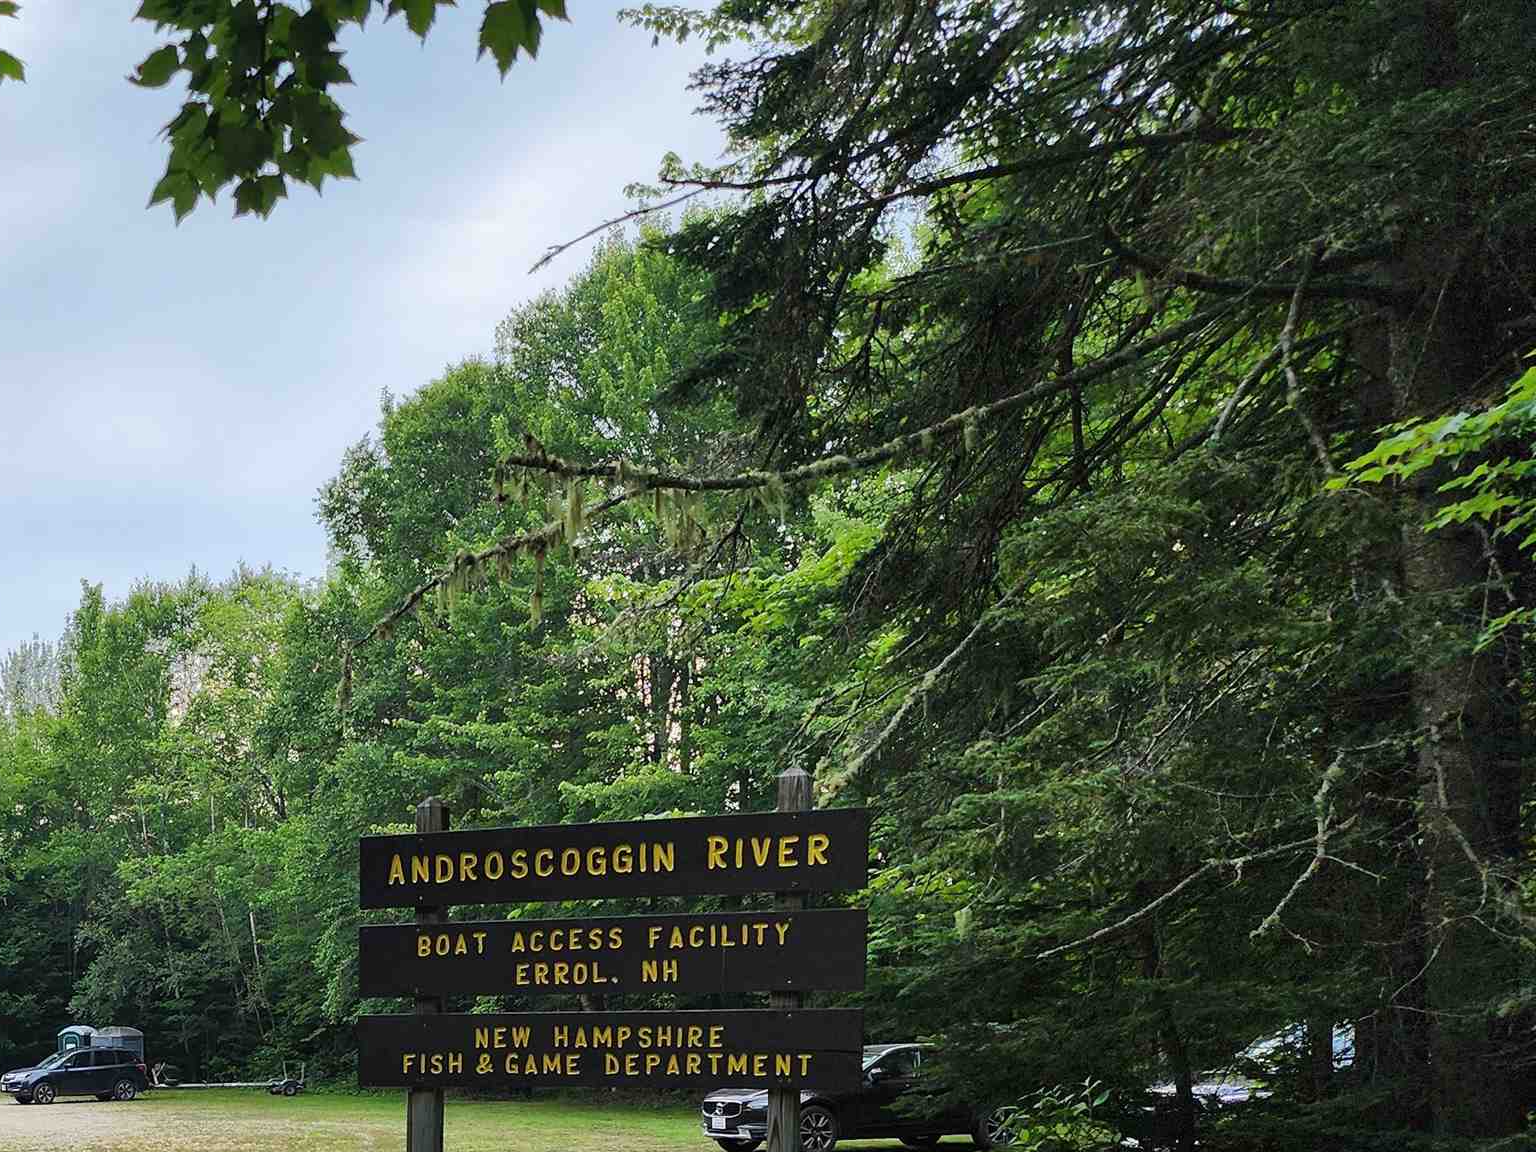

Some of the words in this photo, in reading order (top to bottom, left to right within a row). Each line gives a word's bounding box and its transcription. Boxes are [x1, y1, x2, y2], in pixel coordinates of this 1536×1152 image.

[389, 841, 674, 885] ANDROSCOGGIN
[708, 834, 829, 869] RIVER
[417, 930, 486, 956] BOAT
[512, 928, 622, 952] ACCESS
[649, 921, 790, 948] FACILITY
[642, 960, 677, 982] NH
[476, 1027, 530, 1048] NEW
[555, 1026, 724, 1048] HAMPSHIRE
[403, 1053, 462, 1074] FISH
[476, 1054, 493, 1074] &
[506, 1053, 580, 1075] GAME
[606, 1054, 812, 1076] DEPARTMENT
